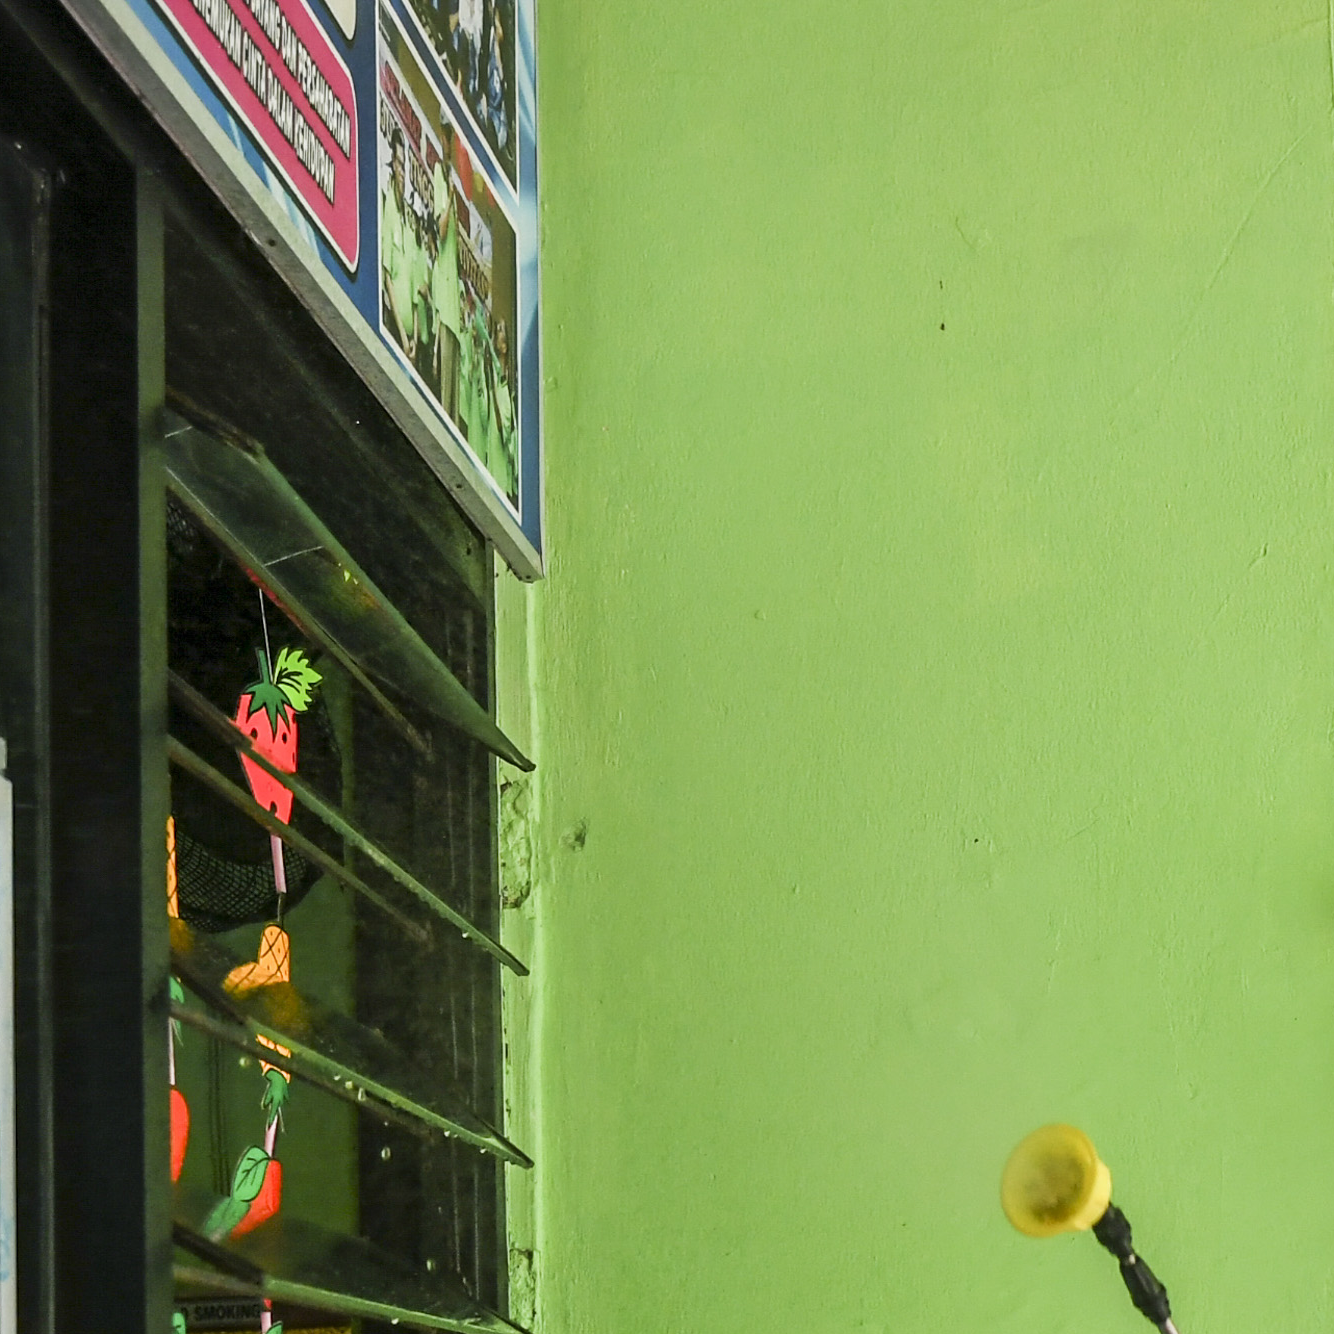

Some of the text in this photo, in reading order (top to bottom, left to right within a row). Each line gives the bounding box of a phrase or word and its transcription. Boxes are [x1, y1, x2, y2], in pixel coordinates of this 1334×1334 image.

[250, 0, 281, 53] AYANG
[280, 12, 298, 81] DAN
[267, 64, 295, 150] DALAM
[294, 107, 335, 207] KEHIDUPAN
